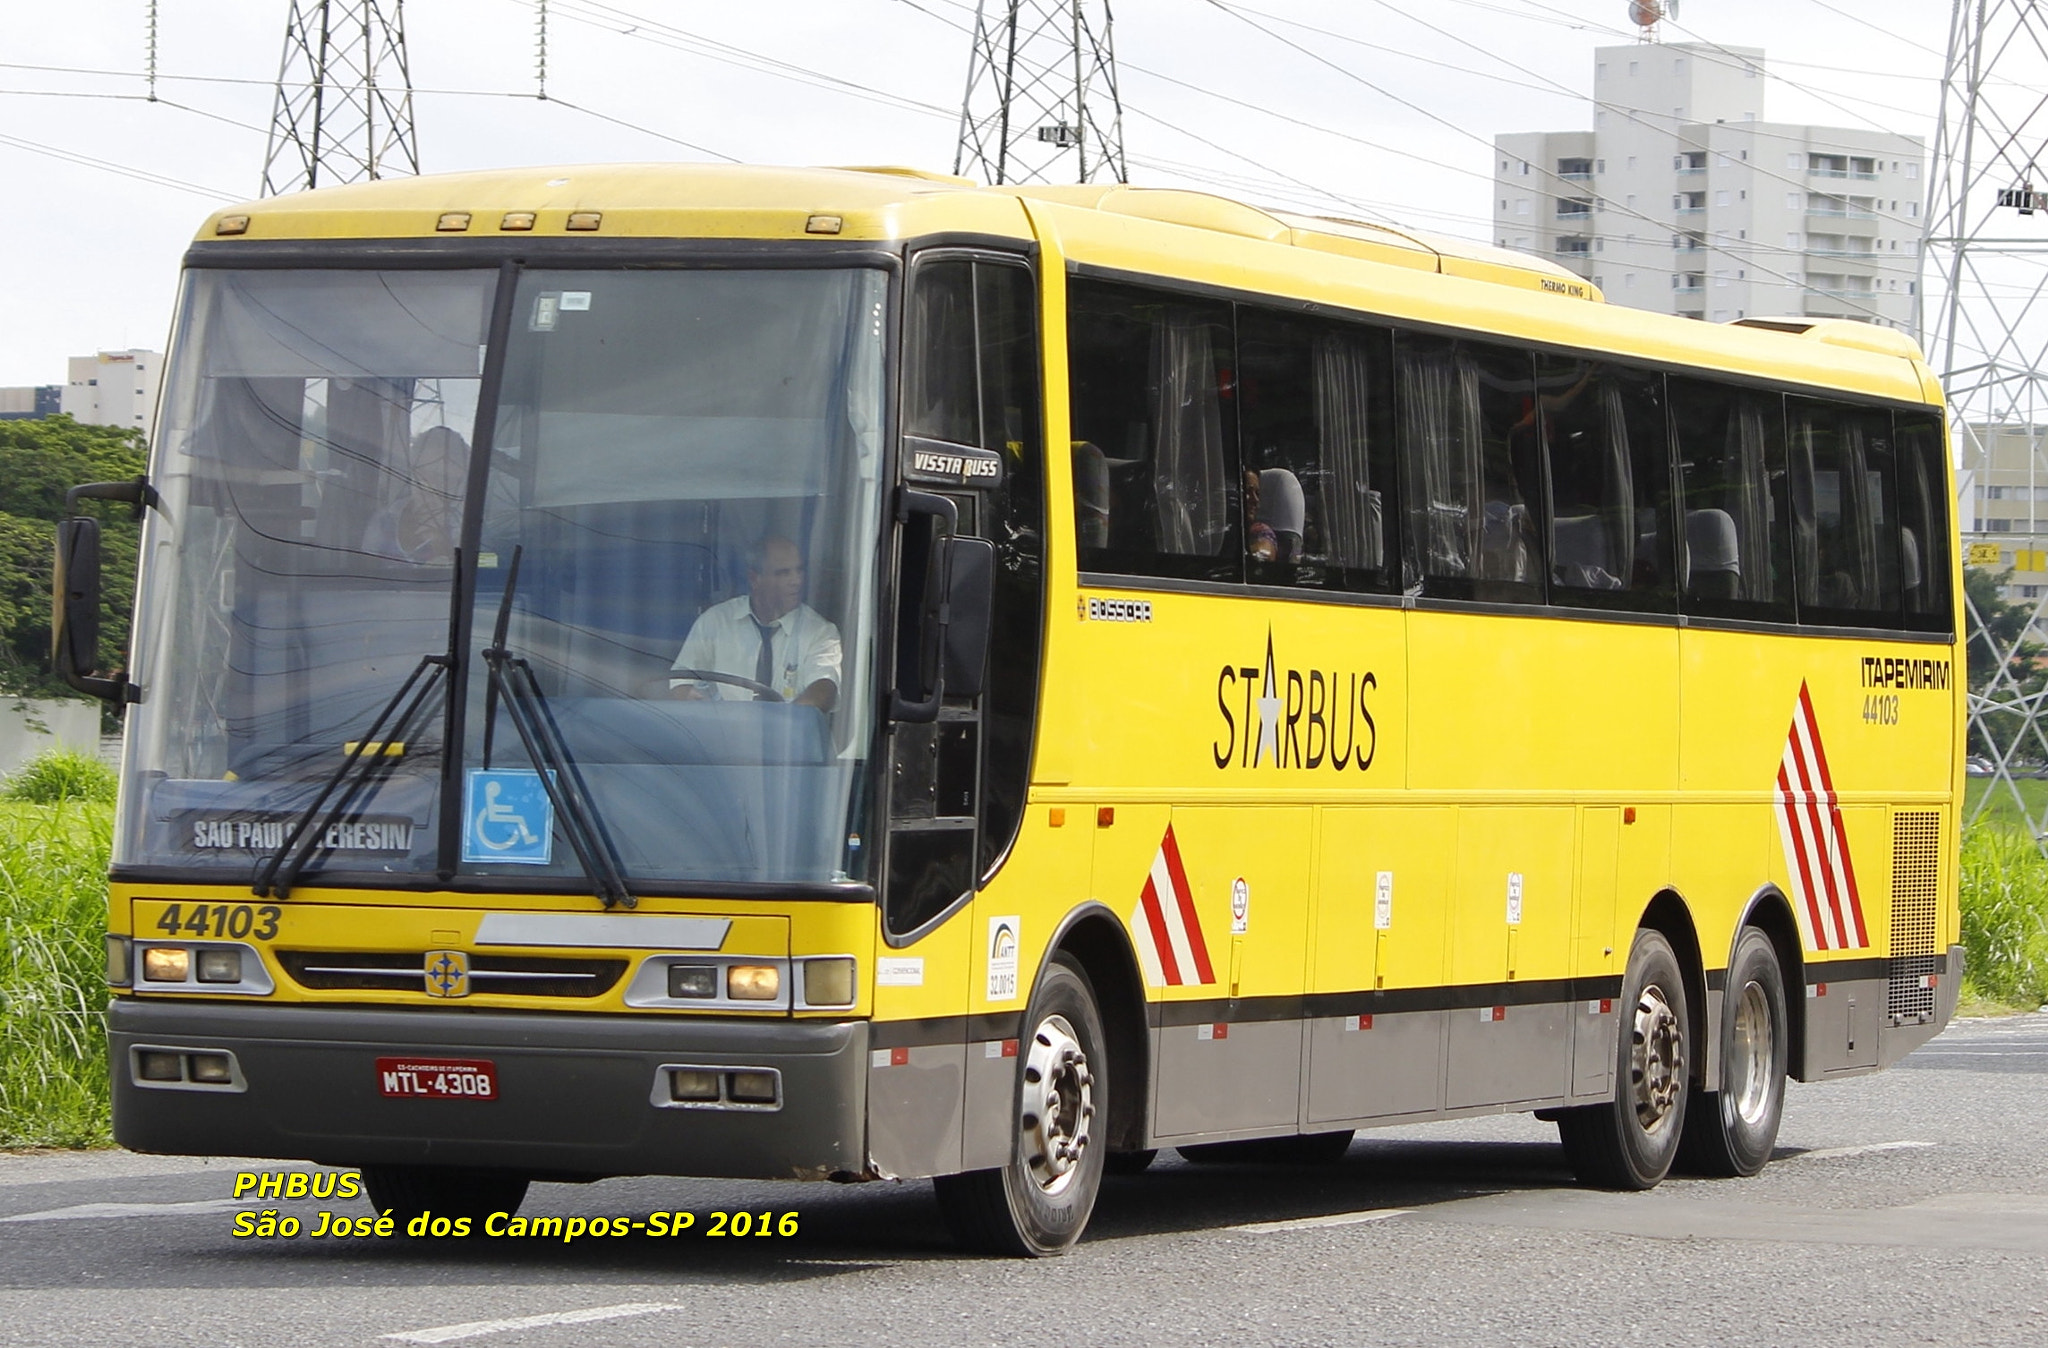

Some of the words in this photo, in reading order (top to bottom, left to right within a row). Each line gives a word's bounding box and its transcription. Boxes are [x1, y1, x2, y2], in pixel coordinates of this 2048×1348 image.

[1540, 279, 1566, 294] THERMO
[1567, 284, 1584, 298] KING
[914, 453, 963, 475] VISSTA
[1861, 657, 1950, 690] ITAPEMIRIM
[1213, 618, 1378, 772] STARBUS
[1862, 694, 1899, 725] 44103
[156, 903, 283, 941] 44103
